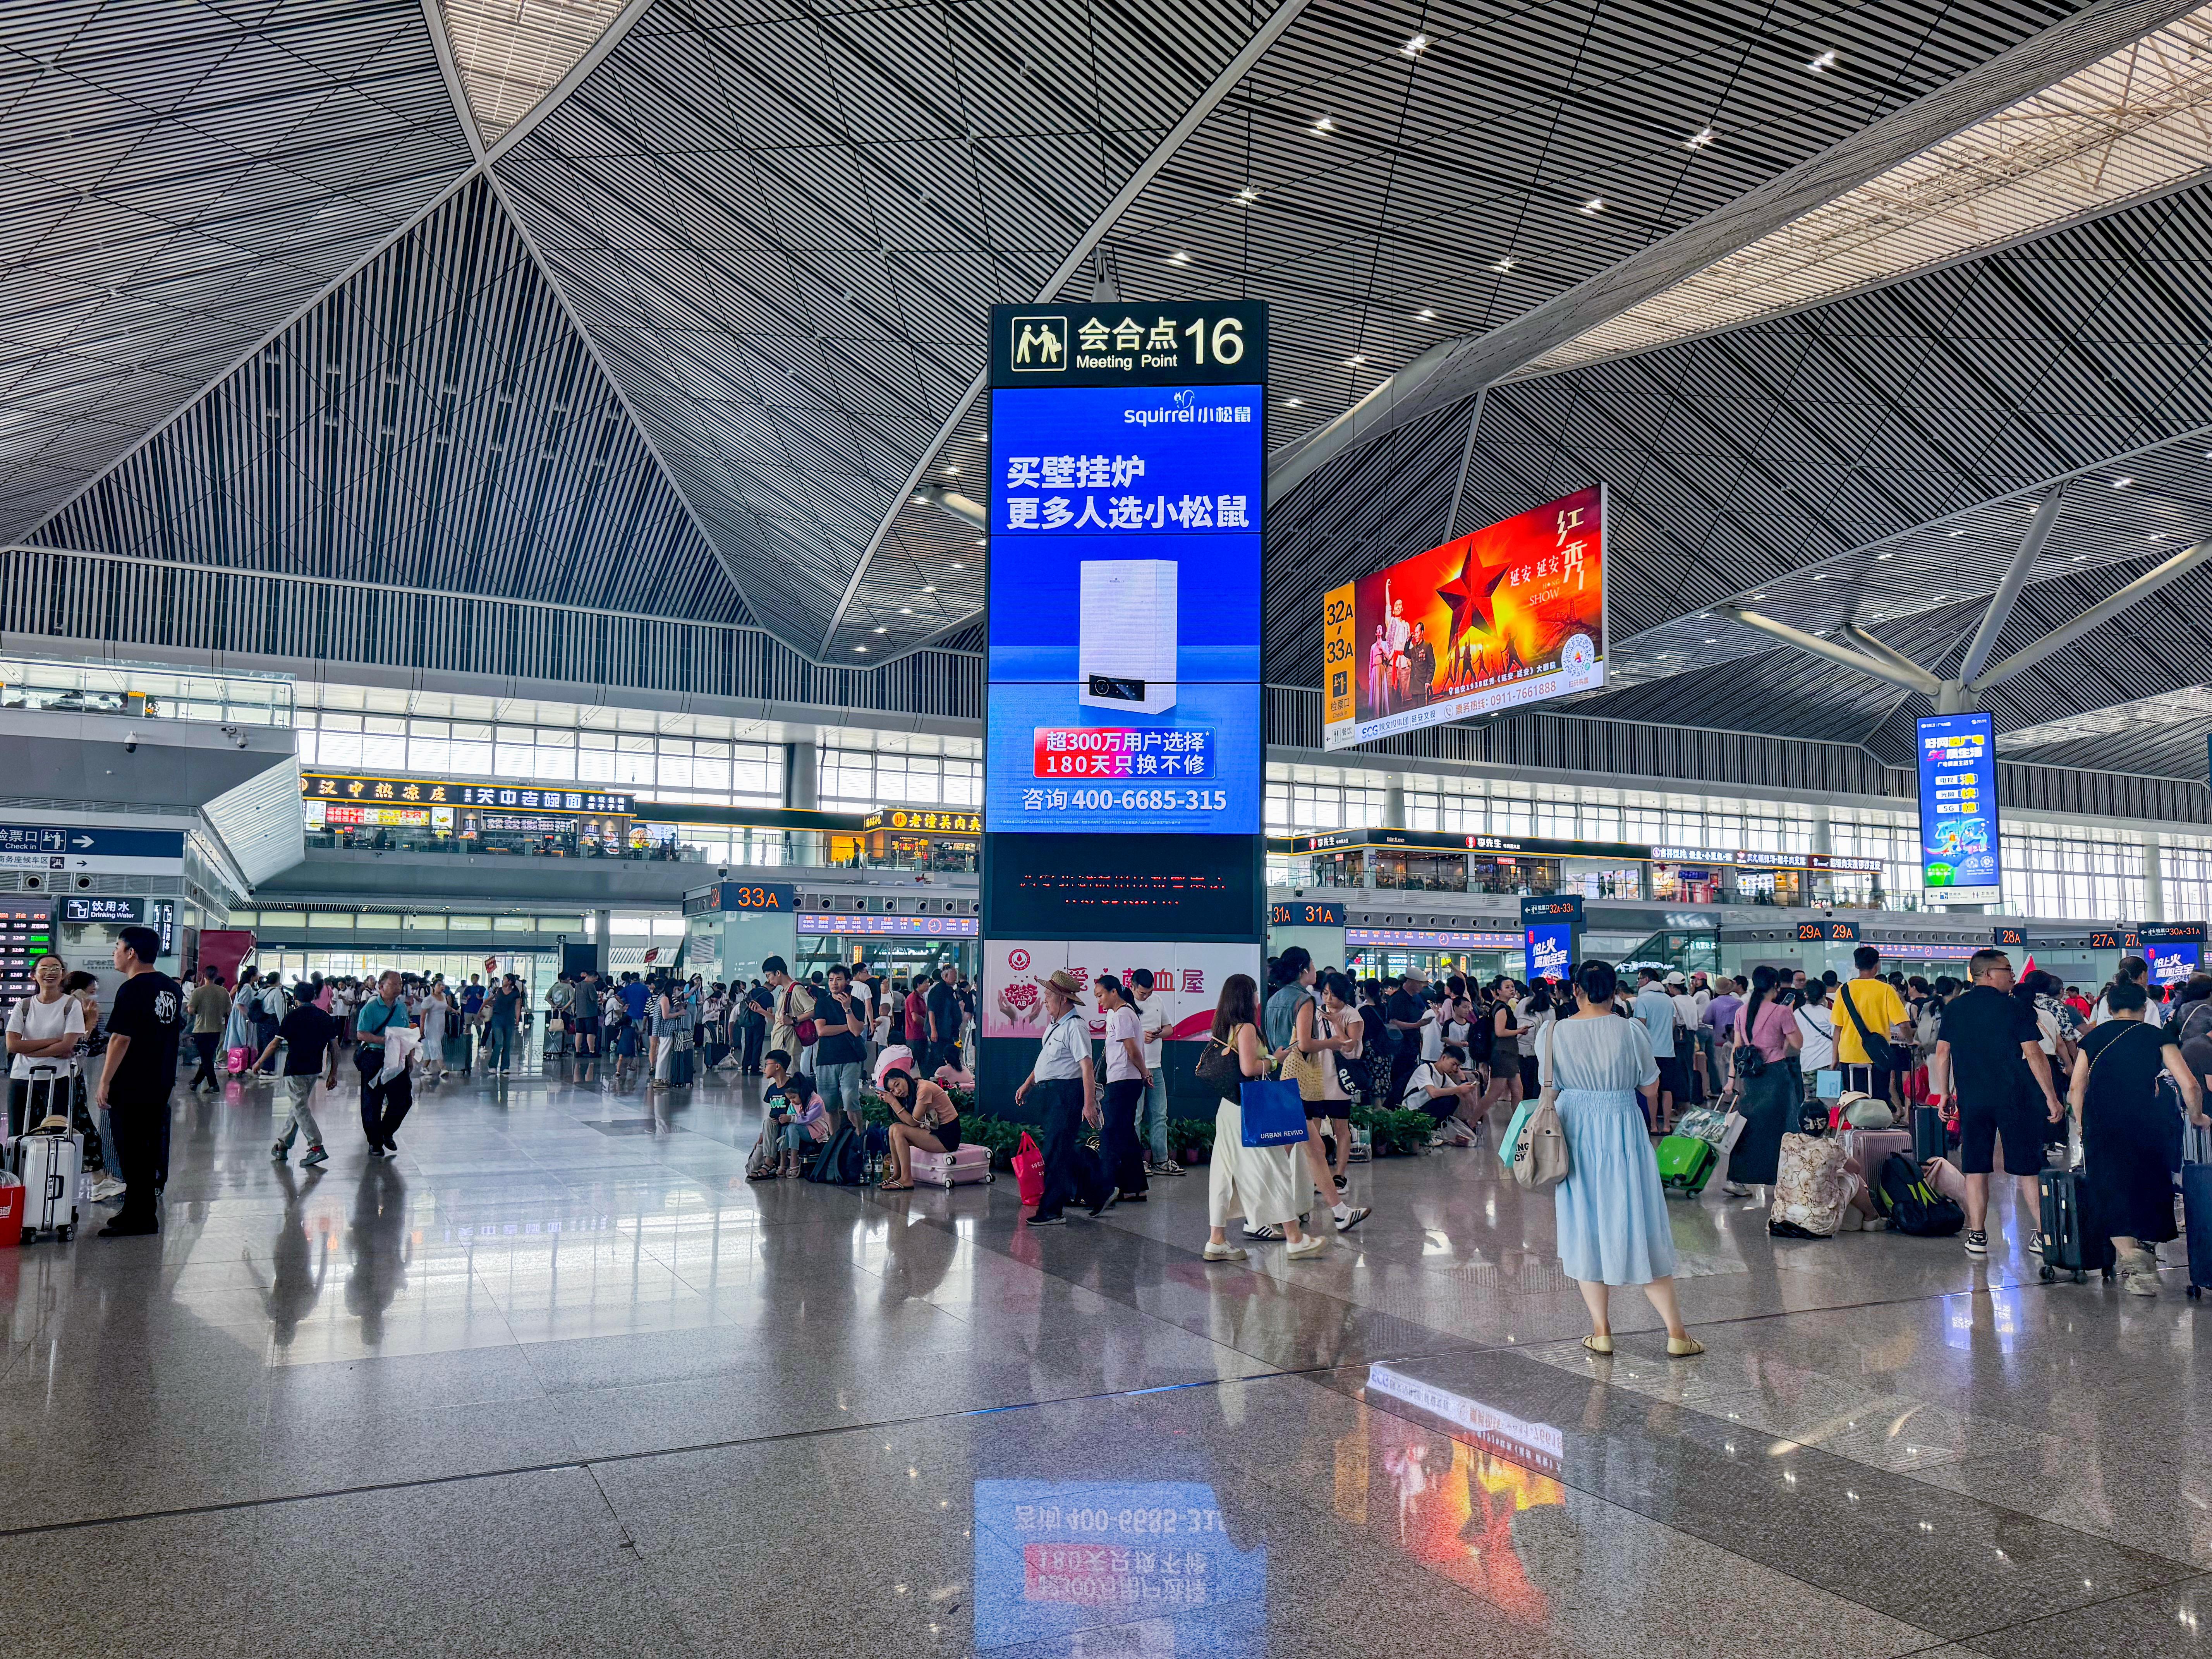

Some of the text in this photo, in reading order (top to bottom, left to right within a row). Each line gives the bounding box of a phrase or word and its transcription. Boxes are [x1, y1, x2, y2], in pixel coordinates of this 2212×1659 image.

[1078, 316, 1244, 364] 会合点 16
[1077, 354, 1178, 371] Meeting Point
[1124, 405, 1251, 426] squirrel 小松鼠
[1006, 455, 1145, 489] 买壁挂炉
[1006, 495, 1249, 529] 更多人选小松鼠
[1510, 555, 1559, 587] 延安 延安
[1530, 587, 1559, 606] SHOW
[1327, 600, 1353, 626] 32A
[1327, 638, 1353, 664] 33A
[1491, 680, 1556, 707] 0911-7661888
[1331, 697, 1350, 712] 检票口
[1047, 755, 1204, 775] 180天只换不修
[319, 780, 447, 801] 汉中热凉皮
[1317, 836, 1335, 847] 李先生
[1477, 838, 1502, 848] 李先生
[738, 887, 779, 907] 33A
[92, 901, 130, 911] 饮用水
[1274, 906, 1291, 922] 31A
[1305, 905, 1334, 922] 31A
[1549, 903, 1574, 914] 32A-33A
[1799, 925, 1822, 939] 29A
[1832, 924, 1853, 939] 29A
[2002, 930, 2021, 943] 28A
[2169, 927, 2200, 936] 30A-31A
[1532, 937, 1557, 957] 怕上火
[2092, 934, 2116, 947] 27A
[1534, 950, 1568, 968] 喝加多宝
[2153, 953, 2183, 969] 怕上火
[2155, 963, 2195, 978] 喝加多宝
